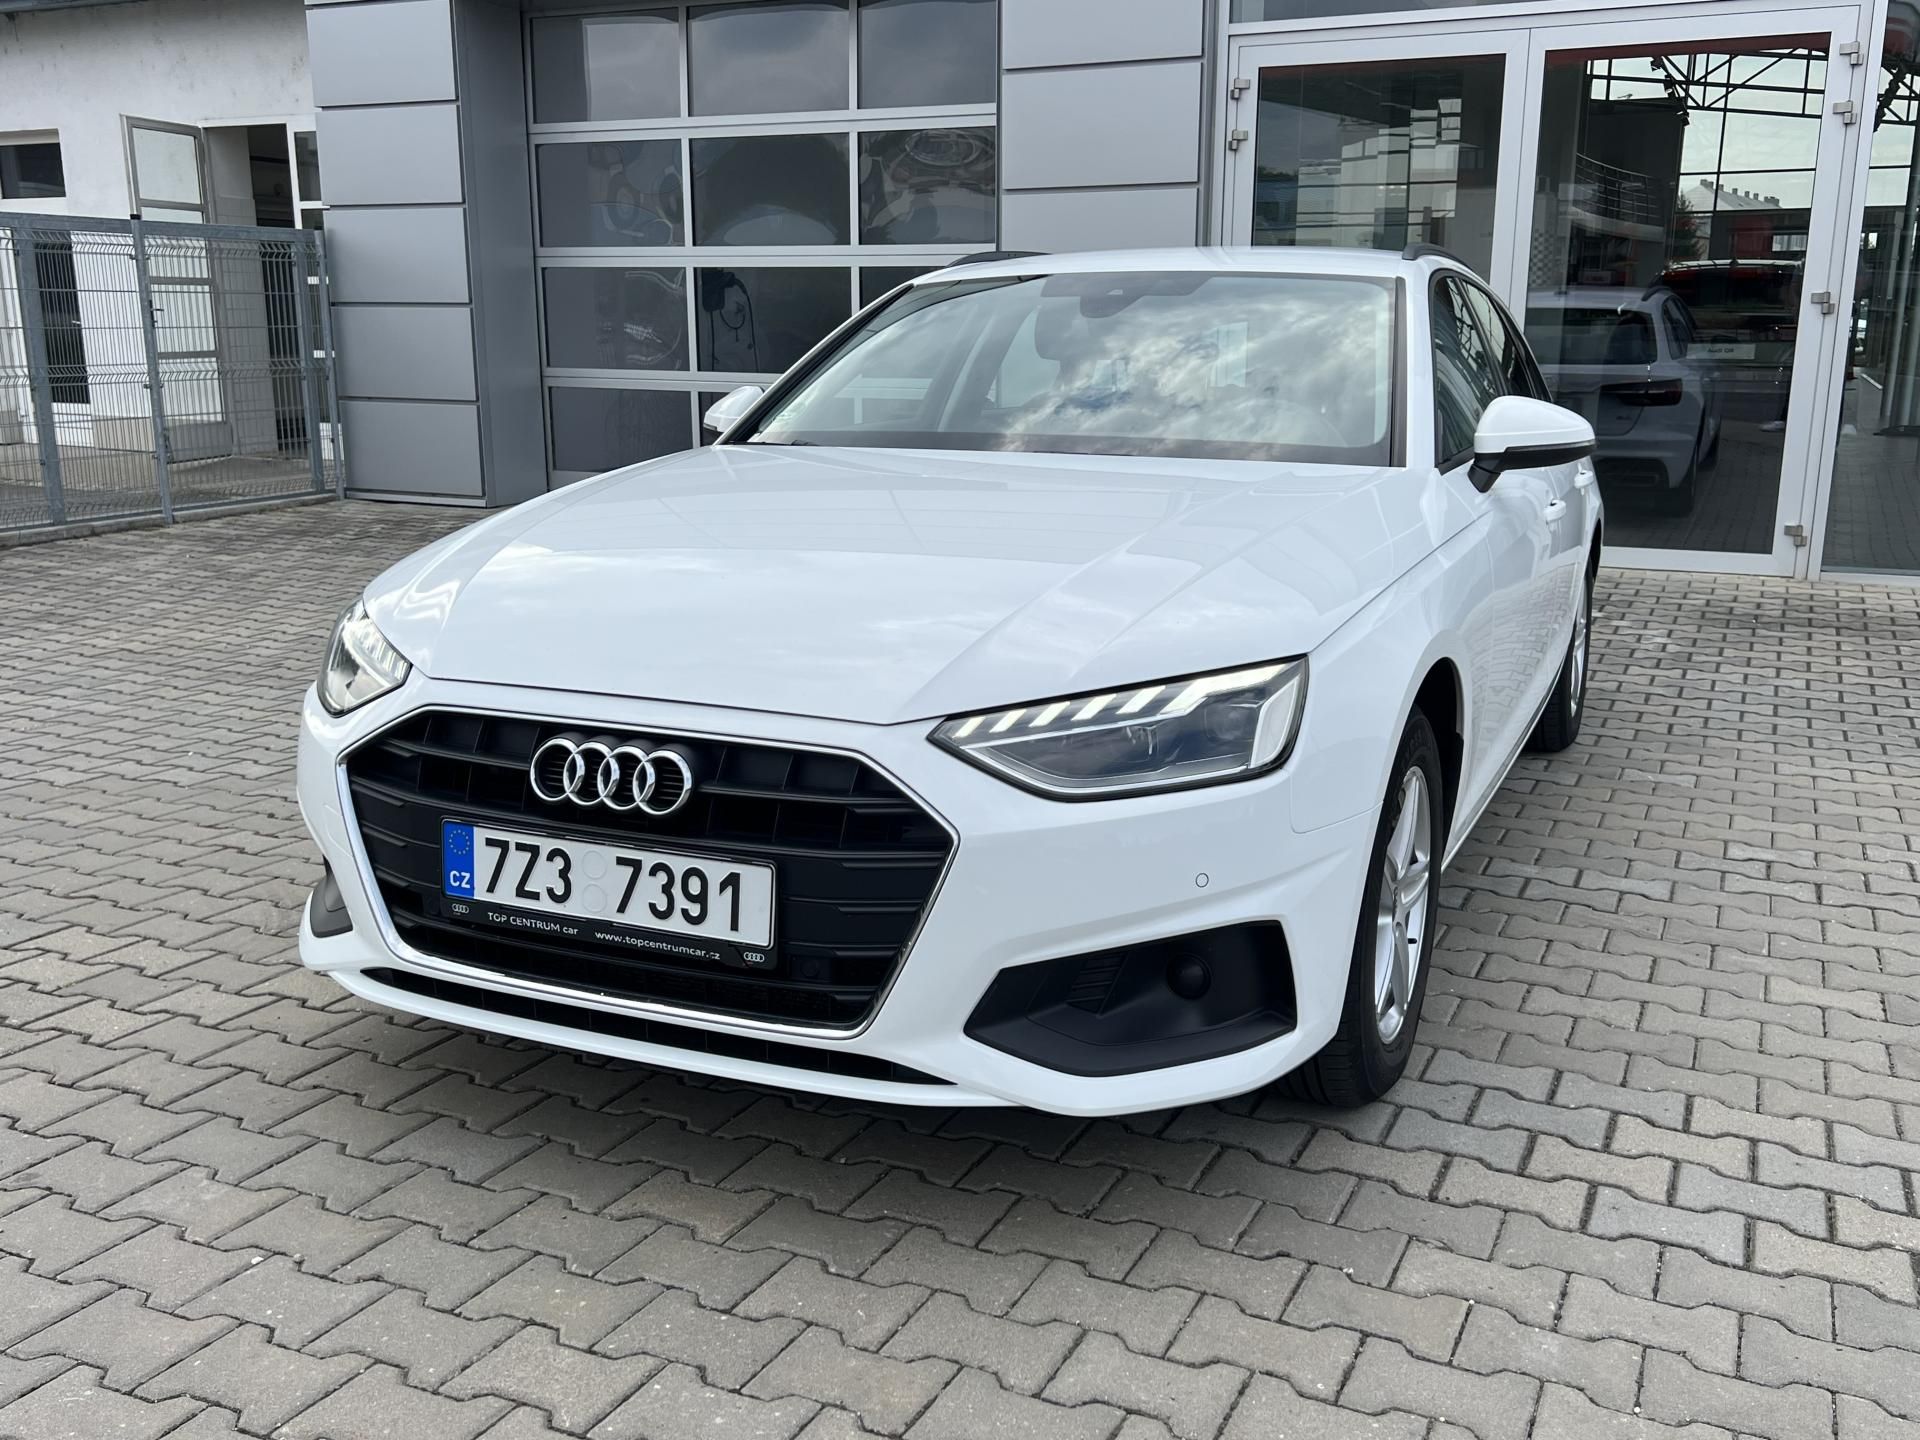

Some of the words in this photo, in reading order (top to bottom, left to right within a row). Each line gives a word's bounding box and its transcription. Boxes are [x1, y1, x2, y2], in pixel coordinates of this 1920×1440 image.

[449, 870, 471, 889] CZ
[485, 837, 572, 904] 7Z3
[615, 855, 741, 932] 7391
[487, 911, 507, 923] TOP
[509, 916, 561, 933] CENTRUM
[562, 926, 579, 935] car
